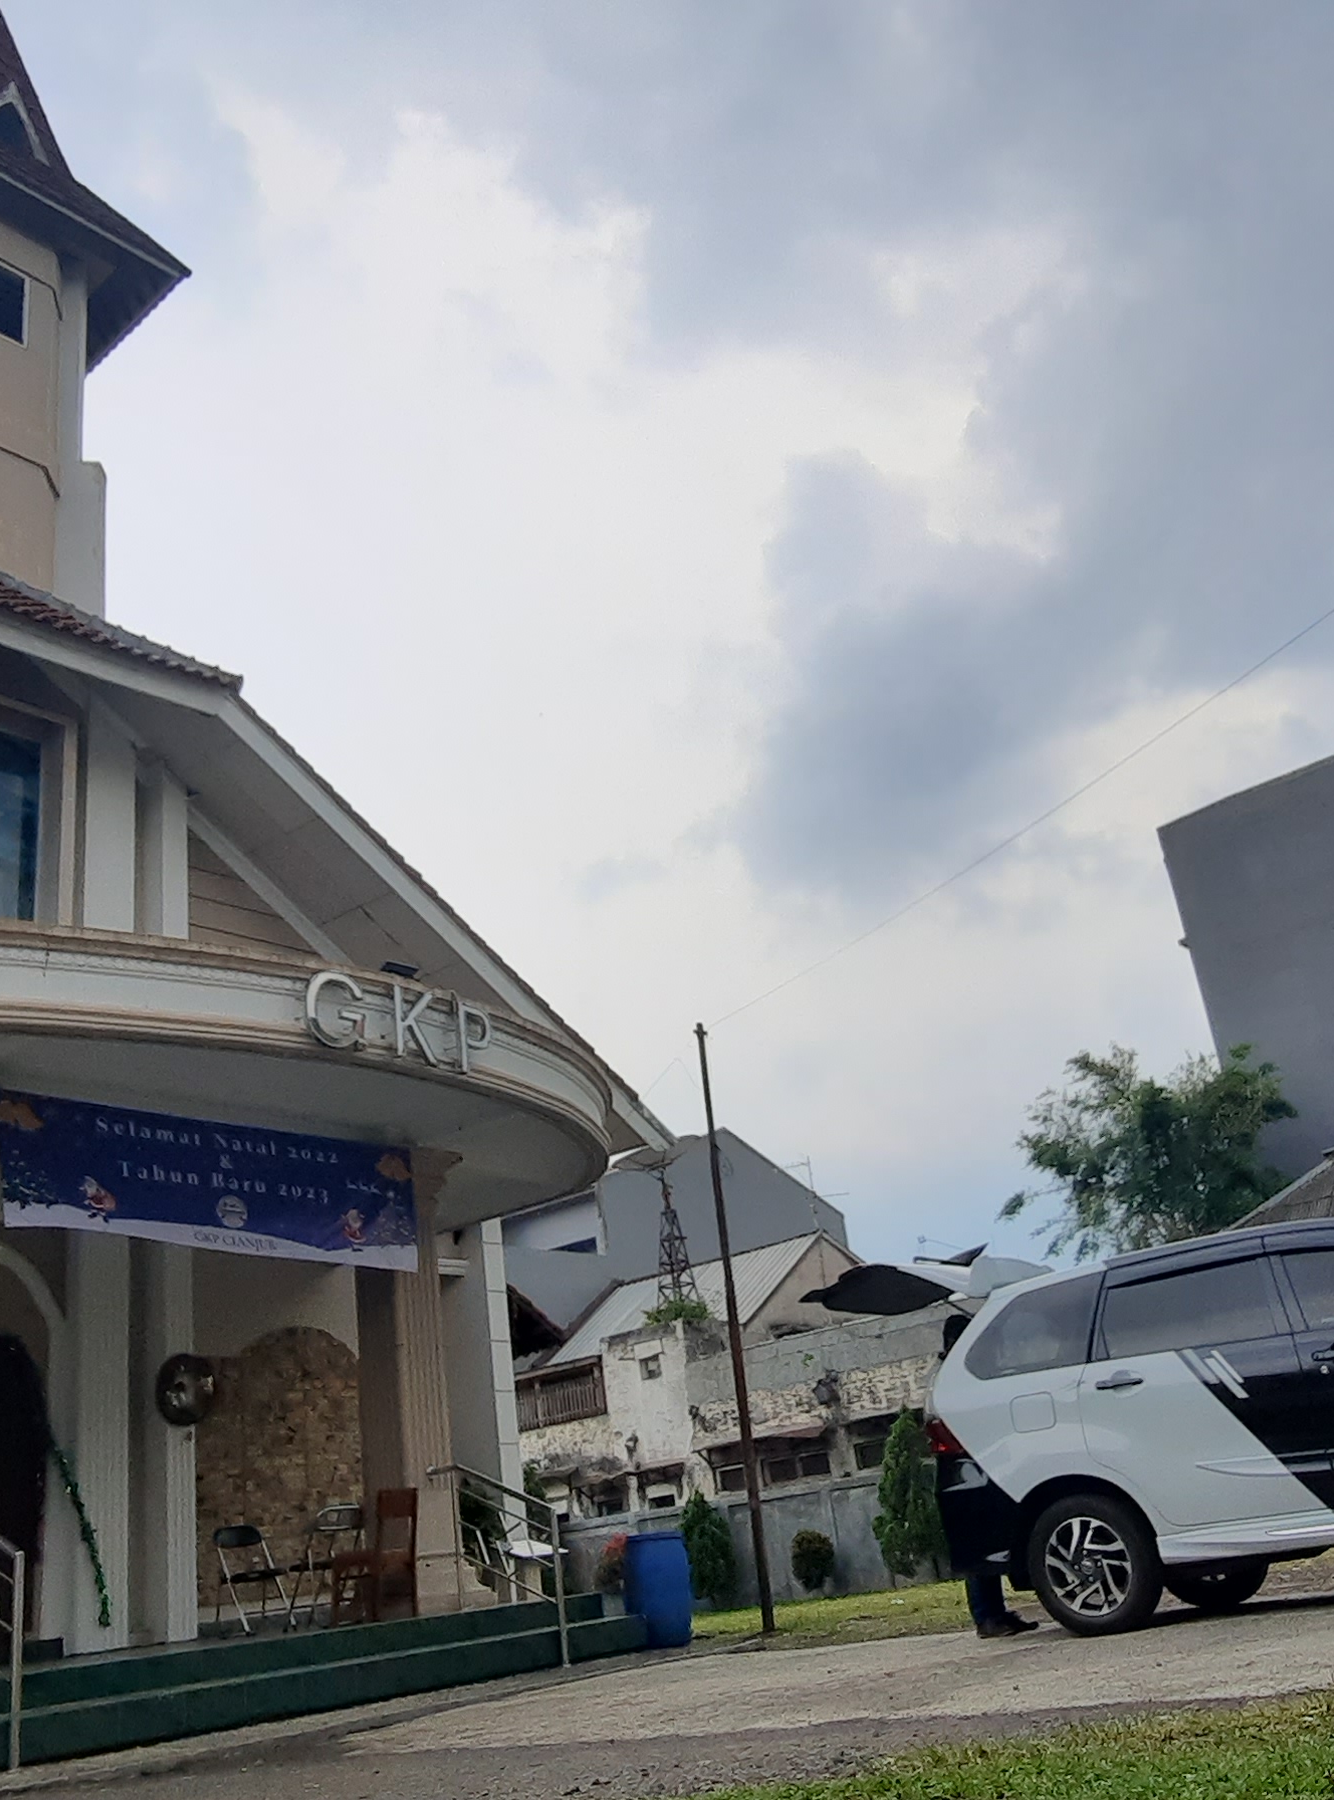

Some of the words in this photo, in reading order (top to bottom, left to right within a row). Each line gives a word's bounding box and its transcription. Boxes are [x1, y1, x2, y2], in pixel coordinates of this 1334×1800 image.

[306, 970, 490, 1074] GKP
[95, 1116, 202, 1146] Selamat
[213, 1132, 276, 1156] Natal
[287, 1146, 339, 1164] 2022
[218, 1154, 234, 1169] &
[117, 1160, 199, 1185] Tahun
[210, 1172, 266, 1193] Baru
[277, 1183, 329, 1204] 2023
